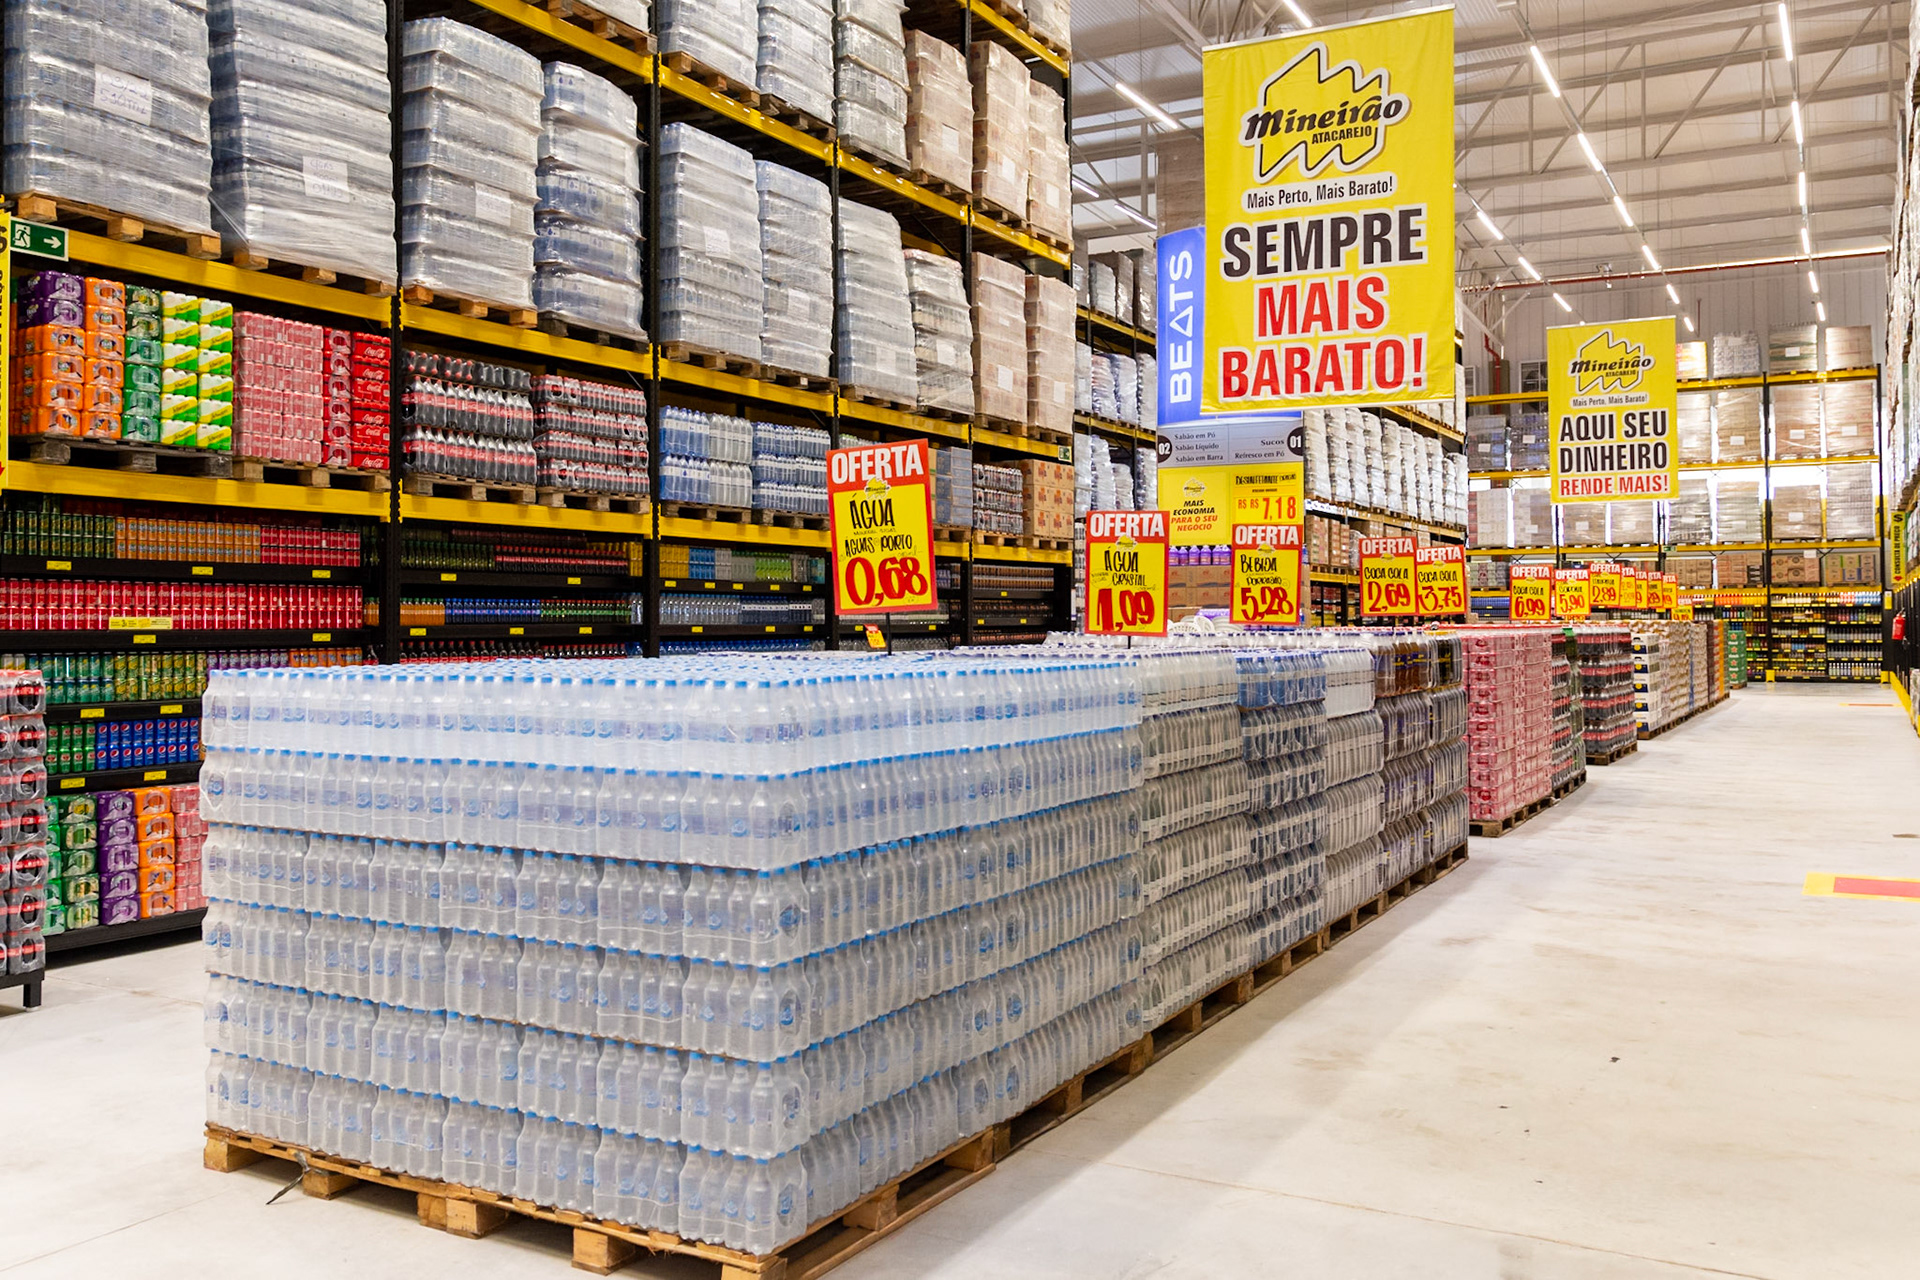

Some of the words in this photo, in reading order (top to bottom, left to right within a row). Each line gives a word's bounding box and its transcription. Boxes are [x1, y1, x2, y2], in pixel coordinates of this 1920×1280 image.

[1245, 95, 1403, 140] Mineirão
[1312, 125, 1372, 144] ATACAREJO
[1247, 192, 1275, 209] Mais
[1278, 189, 1312, 205] Perto,
[1316, 184, 1345, 201] Mais
[1349, 176, 1393, 197] Barato!
[1223, 208, 1424, 278] SEMPRE
[1258, 276, 1385, 338] MAIS
[1222, 338, 1423, 399] BARATO!
[1570, 355, 1652, 374] Mineirão
[1572, 398, 1587, 407] Mais
[1608, 396, 1624, 404] Mais
[1625, 394, 1648, 403] Barato!
[1560, 414, 1614, 442] AQUI
[1624, 410, 1667, 439] SEU
[1174, 432, 1194, 440] Sabão
[1289, 435, 1302, 448] 01
[1159, 443, 1170, 455] 02
[1175, 443, 1194, 451] Sabão
[1195, 443, 1219, 451] Líquido
[1275, 450, 1285, 458] Pó
[831, 444, 924, 485] OFERTA
[1560, 442, 1667, 473] DINHEIRO
[1560, 477, 1612, 496] RENDE
[1619, 474, 1668, 493] MAIS!
[850, 493, 895, 530] ÁGUA
[1171, 516, 1192, 524] PARA
[1173, 507, 1215, 516] ECONOMIA
[1090, 513, 1165, 537] OFERTA
[1176, 523, 1212, 532] NEGÓCIO
[881, 534, 912, 552] PORTO
[1235, 525, 1299, 545] OFERTA
[1361, 538, 1414, 555] OFERTA
[1417, 546, 1462, 562] OFERTA
[1104, 546, 1138, 572] ÁGUA
[1240, 554, 1277, 573] BEBIDA
[1590, 563, 1620, 572] OFERTA
[845, 557, 928, 606] 0,68
[1364, 567, 1386, 579] COCA
[1388, 567, 1408, 579] COLA
[1418, 571, 1437, 582] COCA
[1440, 570, 1457, 581] COLA
[1512, 566, 1550, 578] OFERTA
[1555, 569, 1589, 579] OFERTA
[1241, 586, 1294, 620] 5,28
[1368, 581, 1411, 612] 2,69
[1418, 585, 1462, 611] 3,75
[1097, 588, 1155, 631] 1,09
[1515, 596, 1545, 617] 6,99
